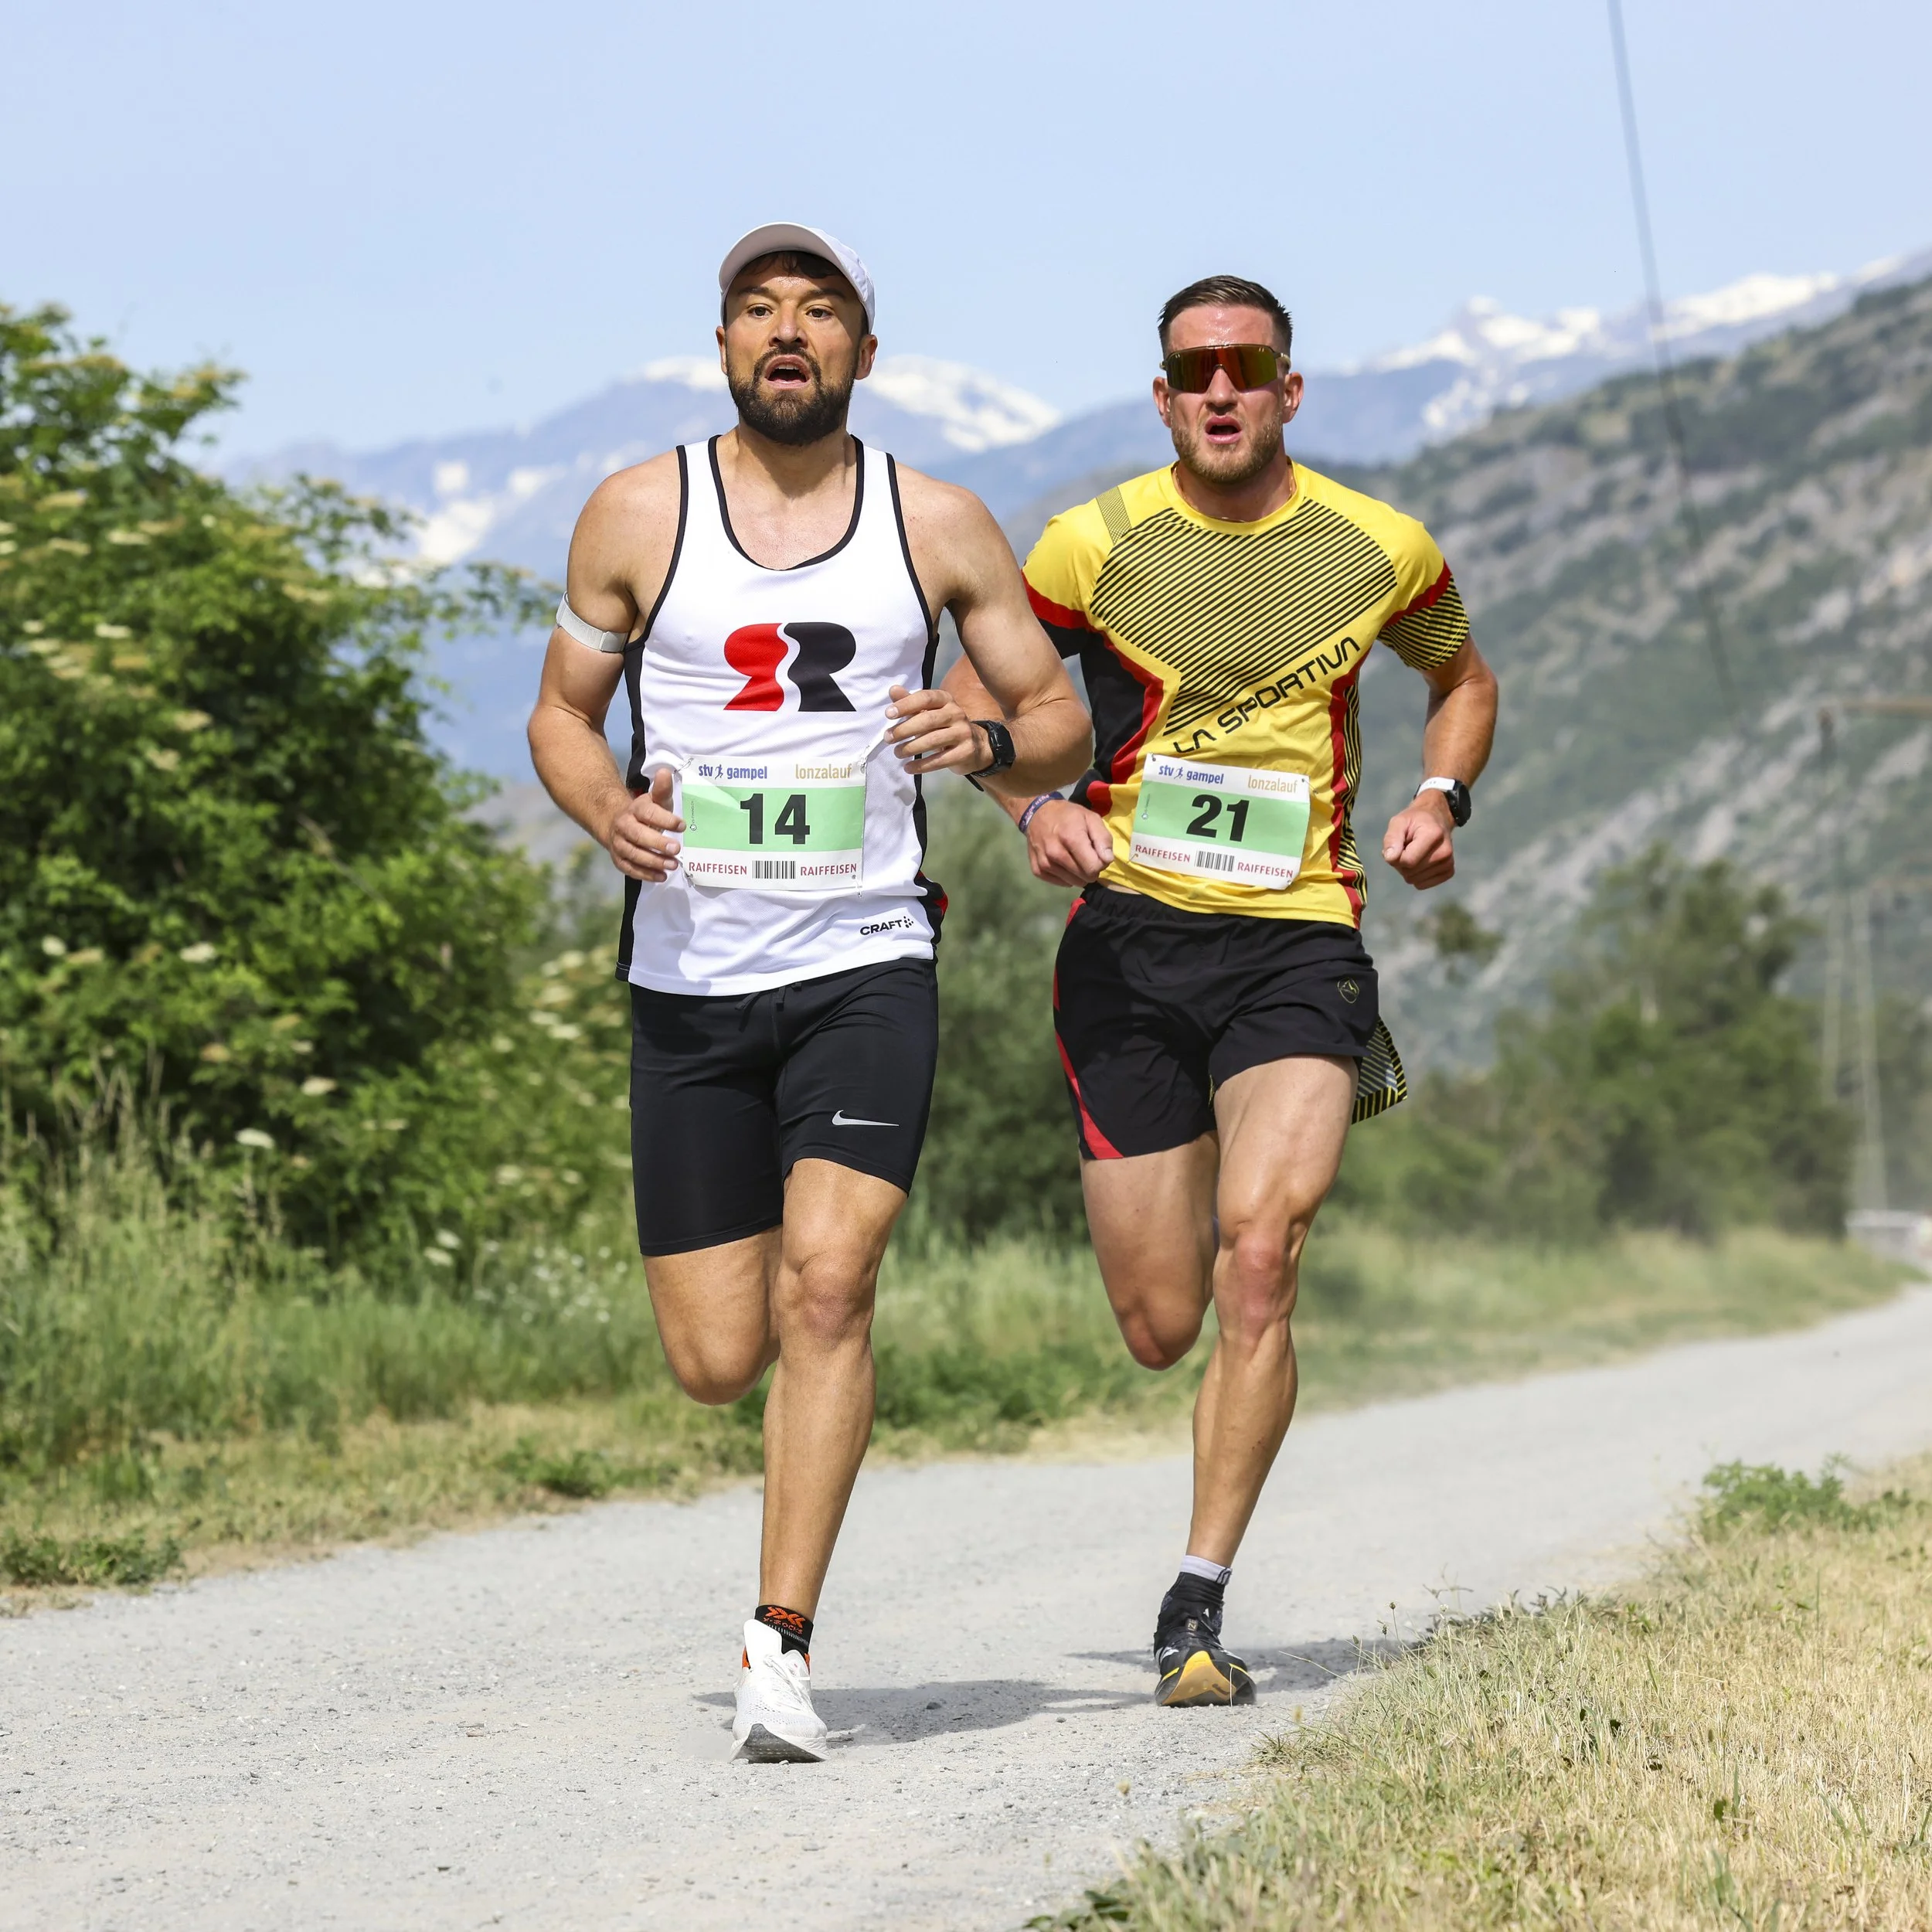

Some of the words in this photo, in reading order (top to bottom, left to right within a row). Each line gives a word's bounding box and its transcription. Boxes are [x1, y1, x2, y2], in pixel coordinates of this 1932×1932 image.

[1173, 728, 1217, 753] LA
[1217, 636, 1361, 734] SPORTIVA
[698, 764, 713, 777] stv
[726, 766, 767, 780] gampel
[795, 764, 852, 779] lonzalauf
[1158, 764, 1175, 777] stv
[1186, 770, 1224, 784] gampel
[1247, 774, 1298, 794] lonzalauf
[740, 793, 811, 845] 14
[1185, 794, 1250, 842] 21
[1135, 845, 1191, 862] RAIFFEISEN
[689, 862, 747, 875] RAIFFEISEN
[801, 862, 857, 876] RAIFFEISEN
[1237, 862, 1294, 879] RAIFFEISEN
[860, 920, 903, 936] CRAFT
